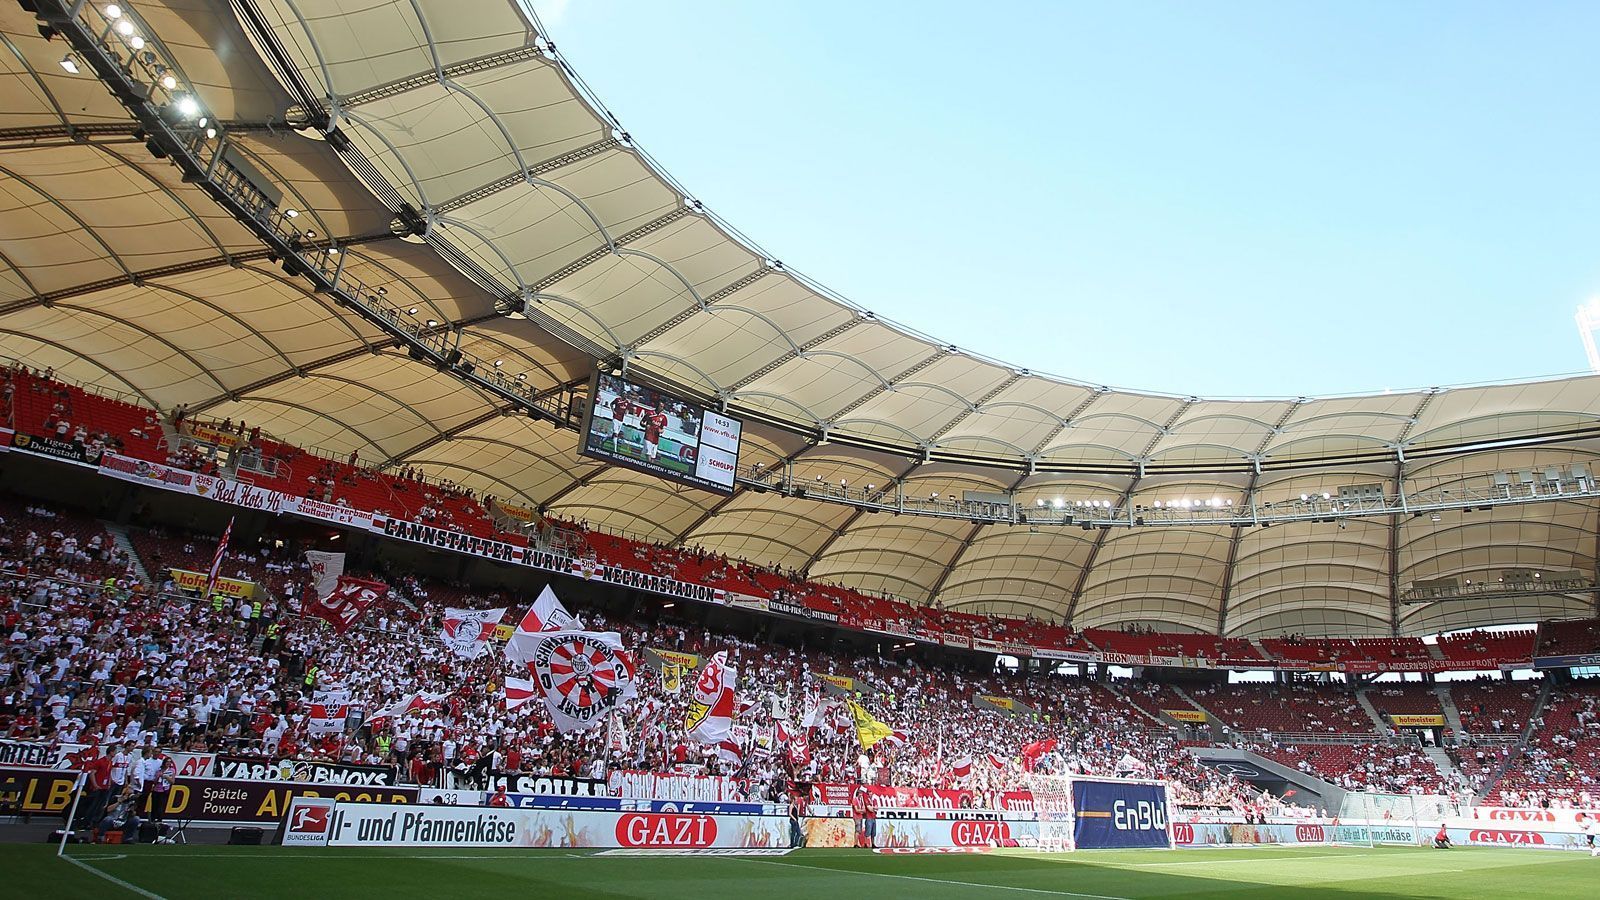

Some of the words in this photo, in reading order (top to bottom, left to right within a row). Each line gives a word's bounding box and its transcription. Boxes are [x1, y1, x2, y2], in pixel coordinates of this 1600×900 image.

[715, 418, 730, 428] 14:53
[704, 426, 737, 440] www.vfb.de
[30, 441, 80, 459] Dornstadt
[44, 437, 73, 450] Tigers
[212, 478, 239, 504] Red
[237, 485, 264, 510] Hots
[265, 491, 280, 512] 96
[297, 504, 334, 520] Stuttgart
[384, 518, 514, 562] CANNSTATTER
[521, 548, 574, 574] KURVE
[180, 572, 242, 594] hofmister
[602, 566, 715, 602] NECKARSTADION
[770, 601, 802, 615] NECKAR-FILS
[811, 611, 838, 622] STUTTGART
[1103, 652, 1127, 662] RHÖN
[1430, 659, 1497, 670] SCHWABENFRONT
[220, 760, 281, 780] YARD
[312, 766, 388, 786] BWOYS
[202, 787, 248, 801] Spätzle
[202, 802, 242, 814] Power
[1114, 800, 1166, 830] EnBW
[357, 811, 398, 842] und
[401, 812, 516, 843] Pfannenkäse
[1361, 828, 1412, 842] Pfnnenkäse
